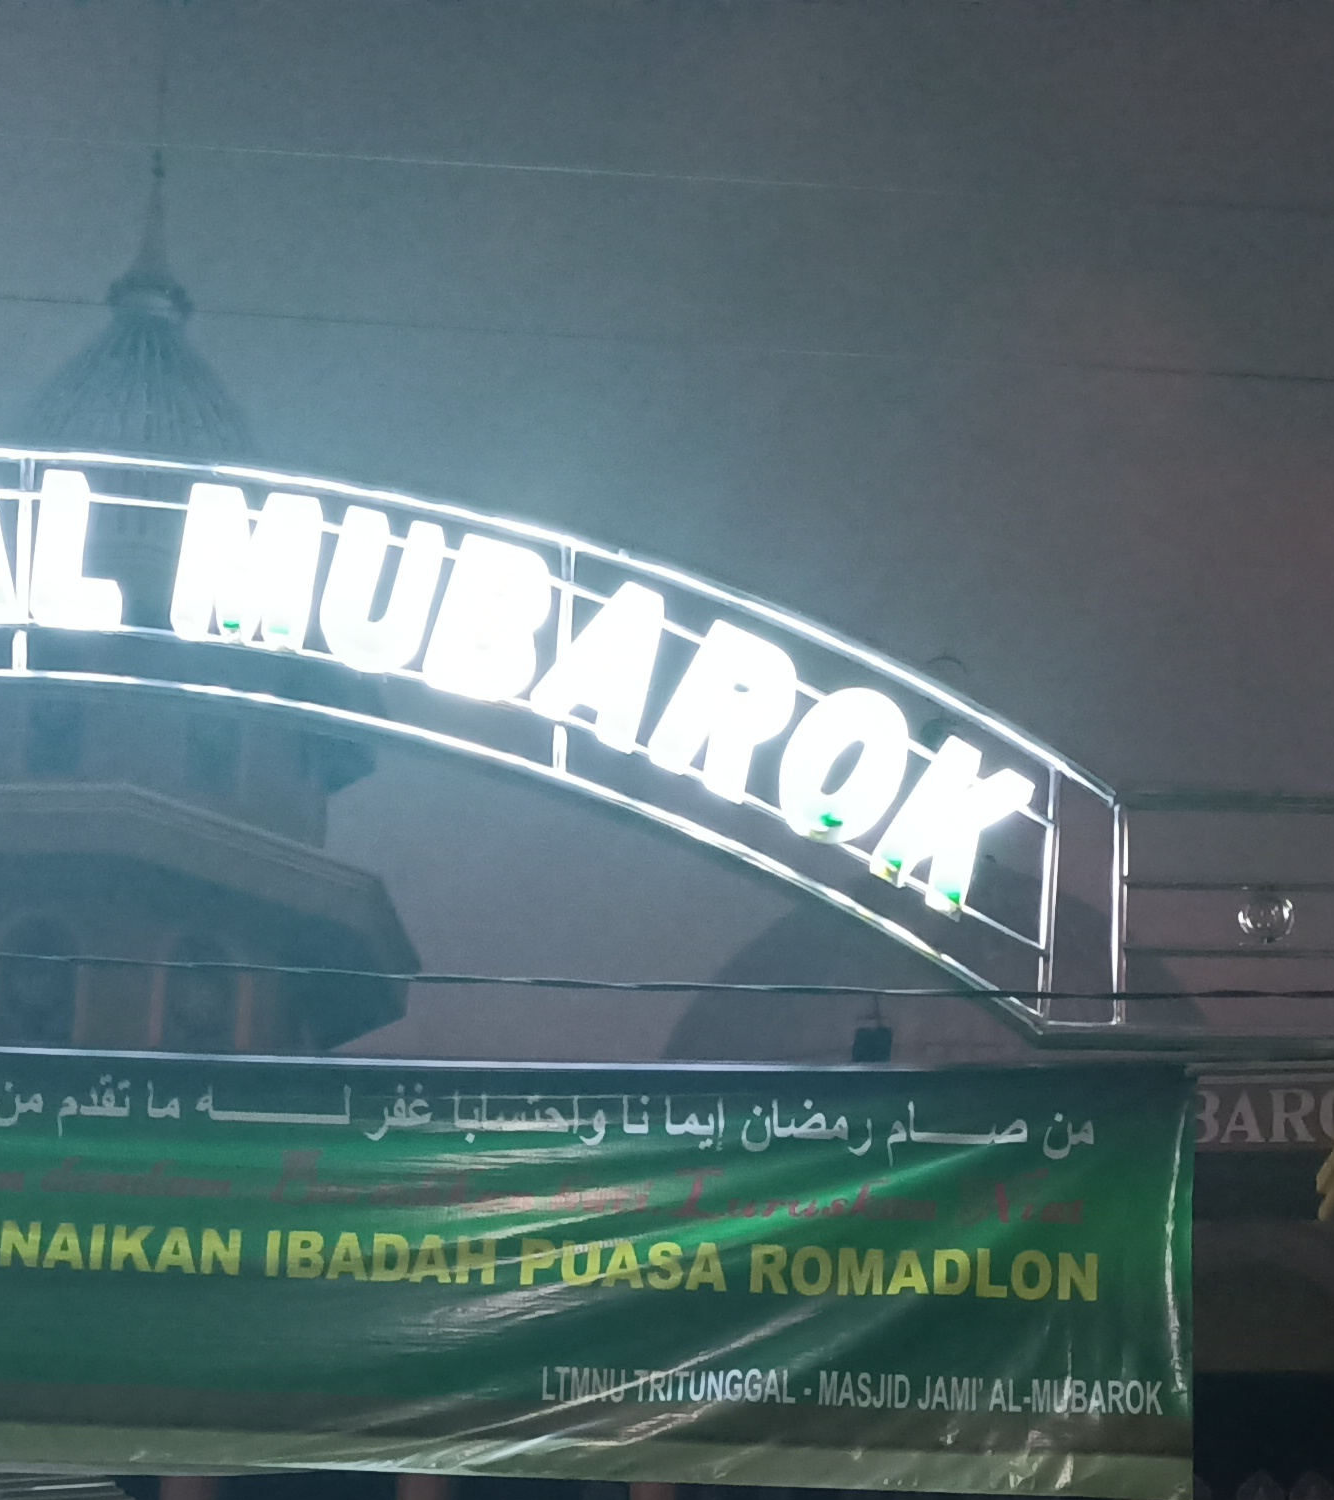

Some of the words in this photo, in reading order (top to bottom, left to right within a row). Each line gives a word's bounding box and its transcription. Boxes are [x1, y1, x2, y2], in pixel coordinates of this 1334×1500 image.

[169, 482, 1035, 921] MUBAROK
[57, 1073, 131, 1138] تقدم
[147, 1080, 180, 1118] ما
[364, 1082, 432, 1141] غفر
[741, 1098, 872, 1156] رمضان
[1043, 1112, 1094, 1159] من
[266, 1229, 497, 1286] IBADAH
[519, 1237, 727, 1295] PUASA
[750, 1243, 1098, 1302] ROMADLON
[541, 1366, 626, 1404] LTMNU
[634, 1368, 796, 1405] TRITUNGGAL
[817, 1370, 911, 1409] MASJID
[988, 1378, 1164, 1416] AL-MUBAROK
